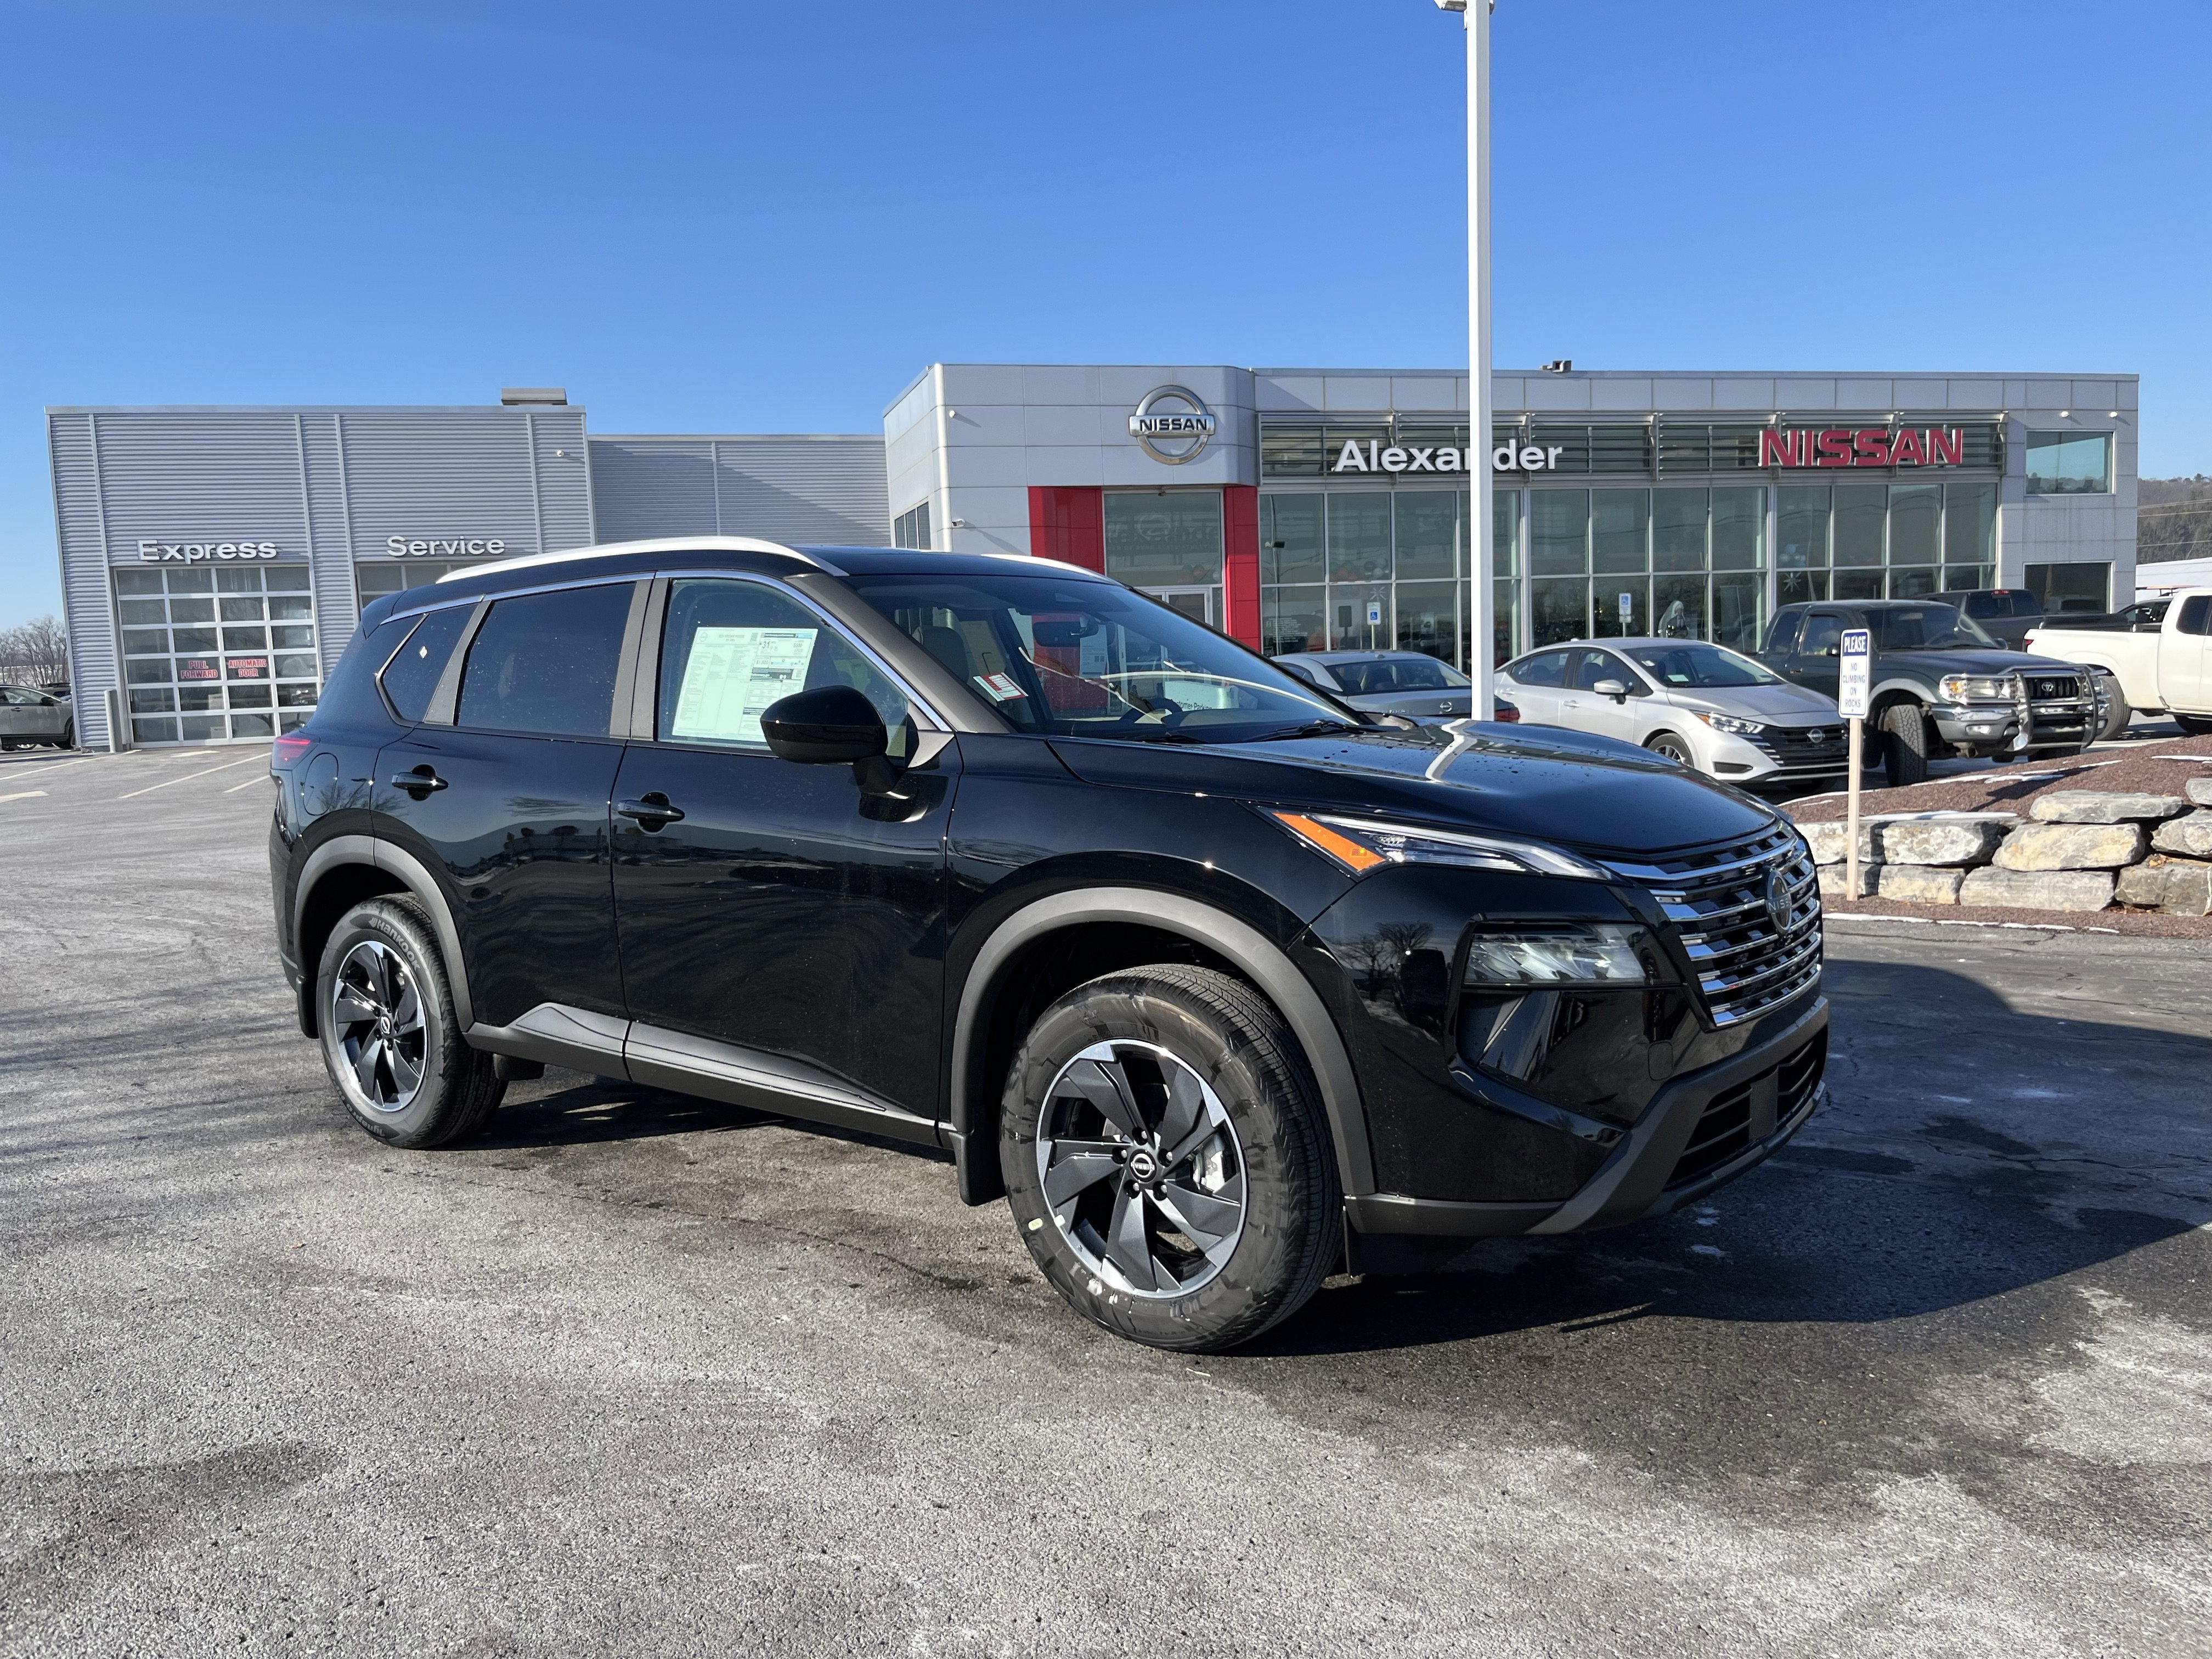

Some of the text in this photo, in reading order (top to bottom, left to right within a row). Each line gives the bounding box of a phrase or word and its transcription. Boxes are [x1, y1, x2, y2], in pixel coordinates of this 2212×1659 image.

[1138, 417, 1209, 432] NISSAN
[1758, 428, 1963, 467] NISSAN
[386, 535, 505, 556] Service
[136, 539, 277, 564] Express
[1844, 635, 1866, 653] PLEASE
[189, 661, 208, 669] PULL
[228, 659, 267, 668] AUTOMATIC
[1850, 663, 1857, 671] NO
[180, 669, 218, 679] FORWARD
[238, 668, 259, 677] DOOR
[1842, 675, 1865, 683] CLIMBING
[1850, 687, 1857, 696] ON
[1845, 699, 1861, 708] ROCKS
